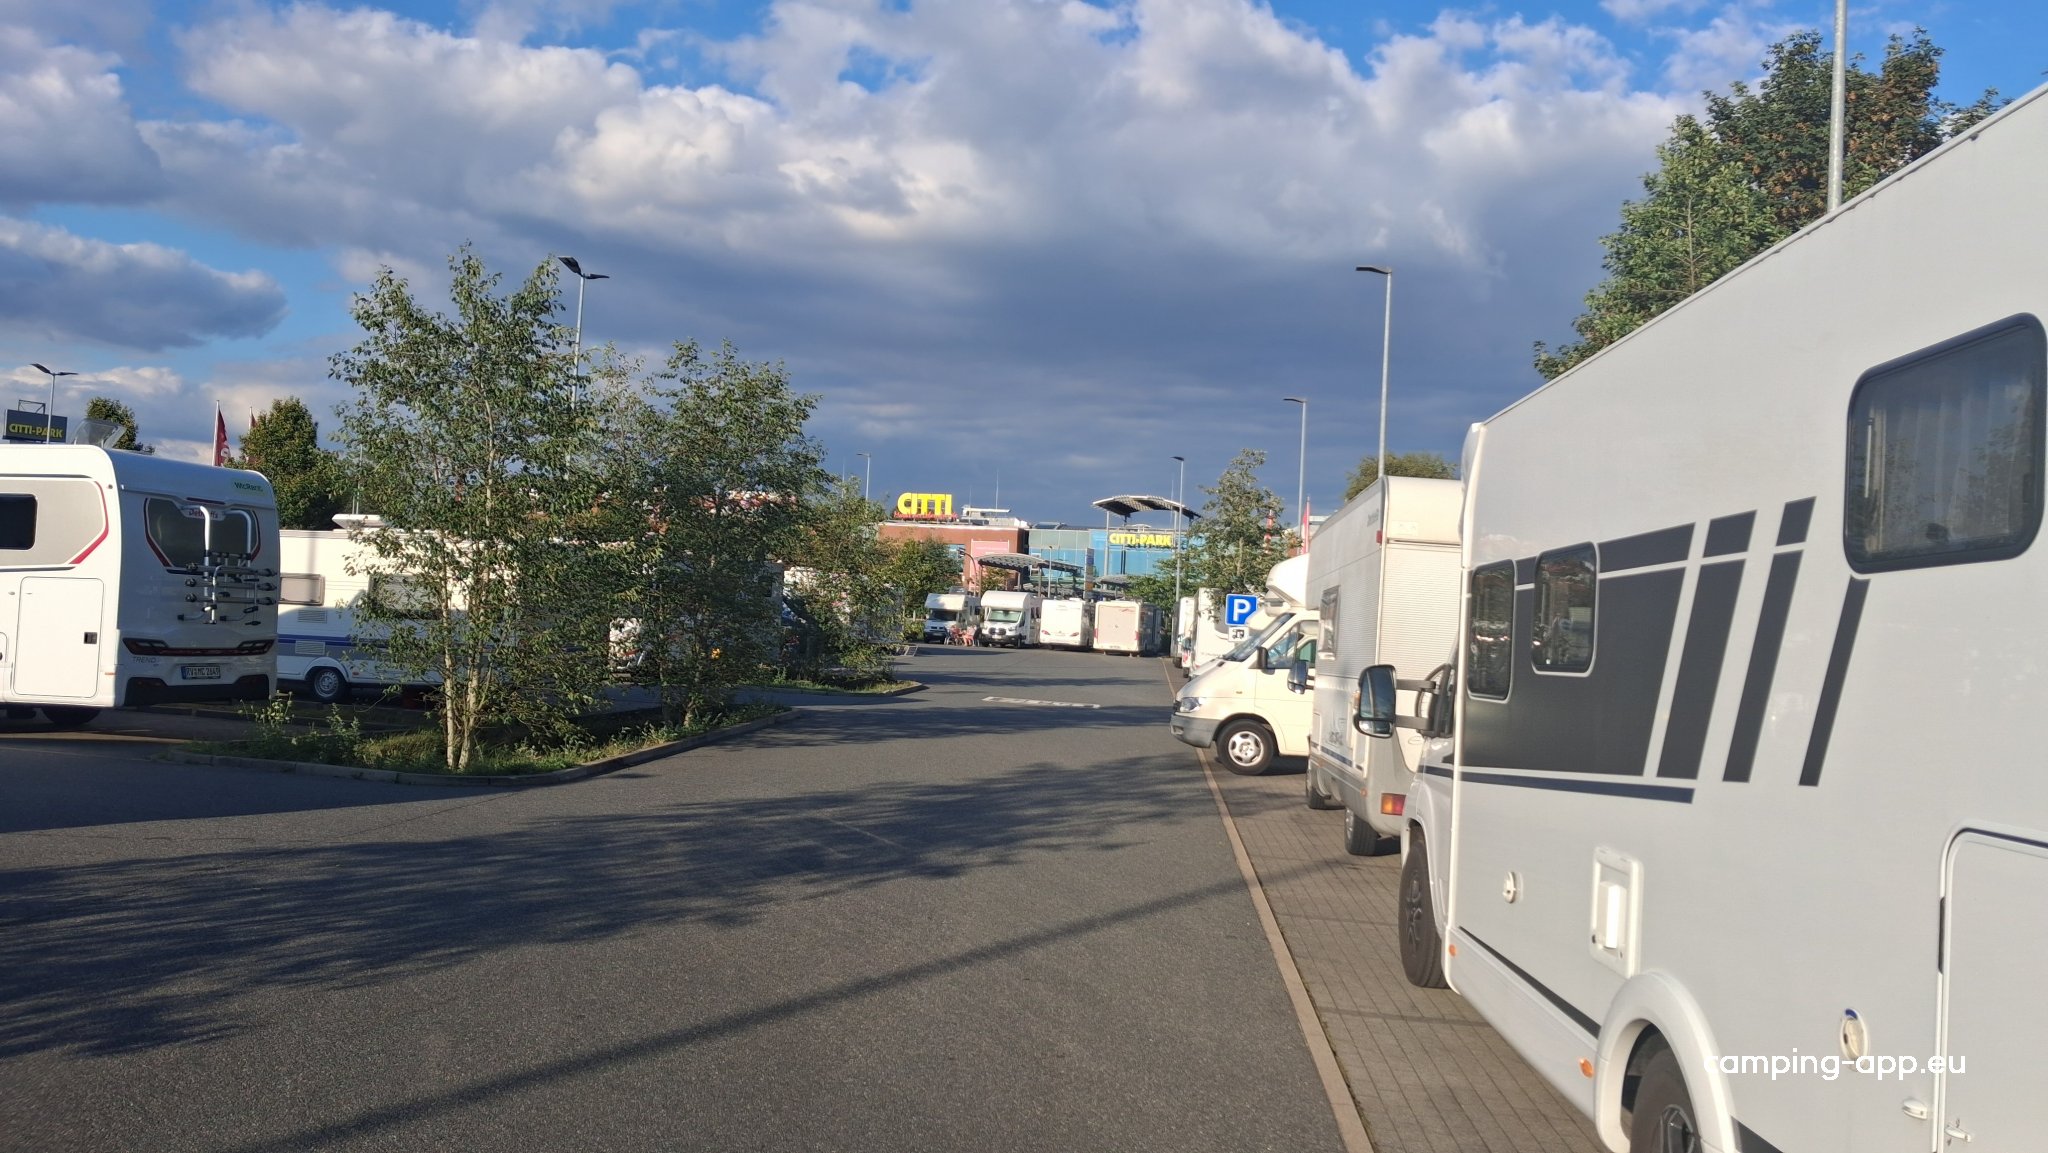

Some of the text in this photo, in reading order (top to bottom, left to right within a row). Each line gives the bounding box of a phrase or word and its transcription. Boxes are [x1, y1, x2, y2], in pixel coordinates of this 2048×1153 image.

[9, 423, 63, 438] CITTI-PARK
[897, 492, 952, 516] CITTI
[1109, 533, 1172, 547] CITTI-PARK
[1232, 598, 1251, 622] P
